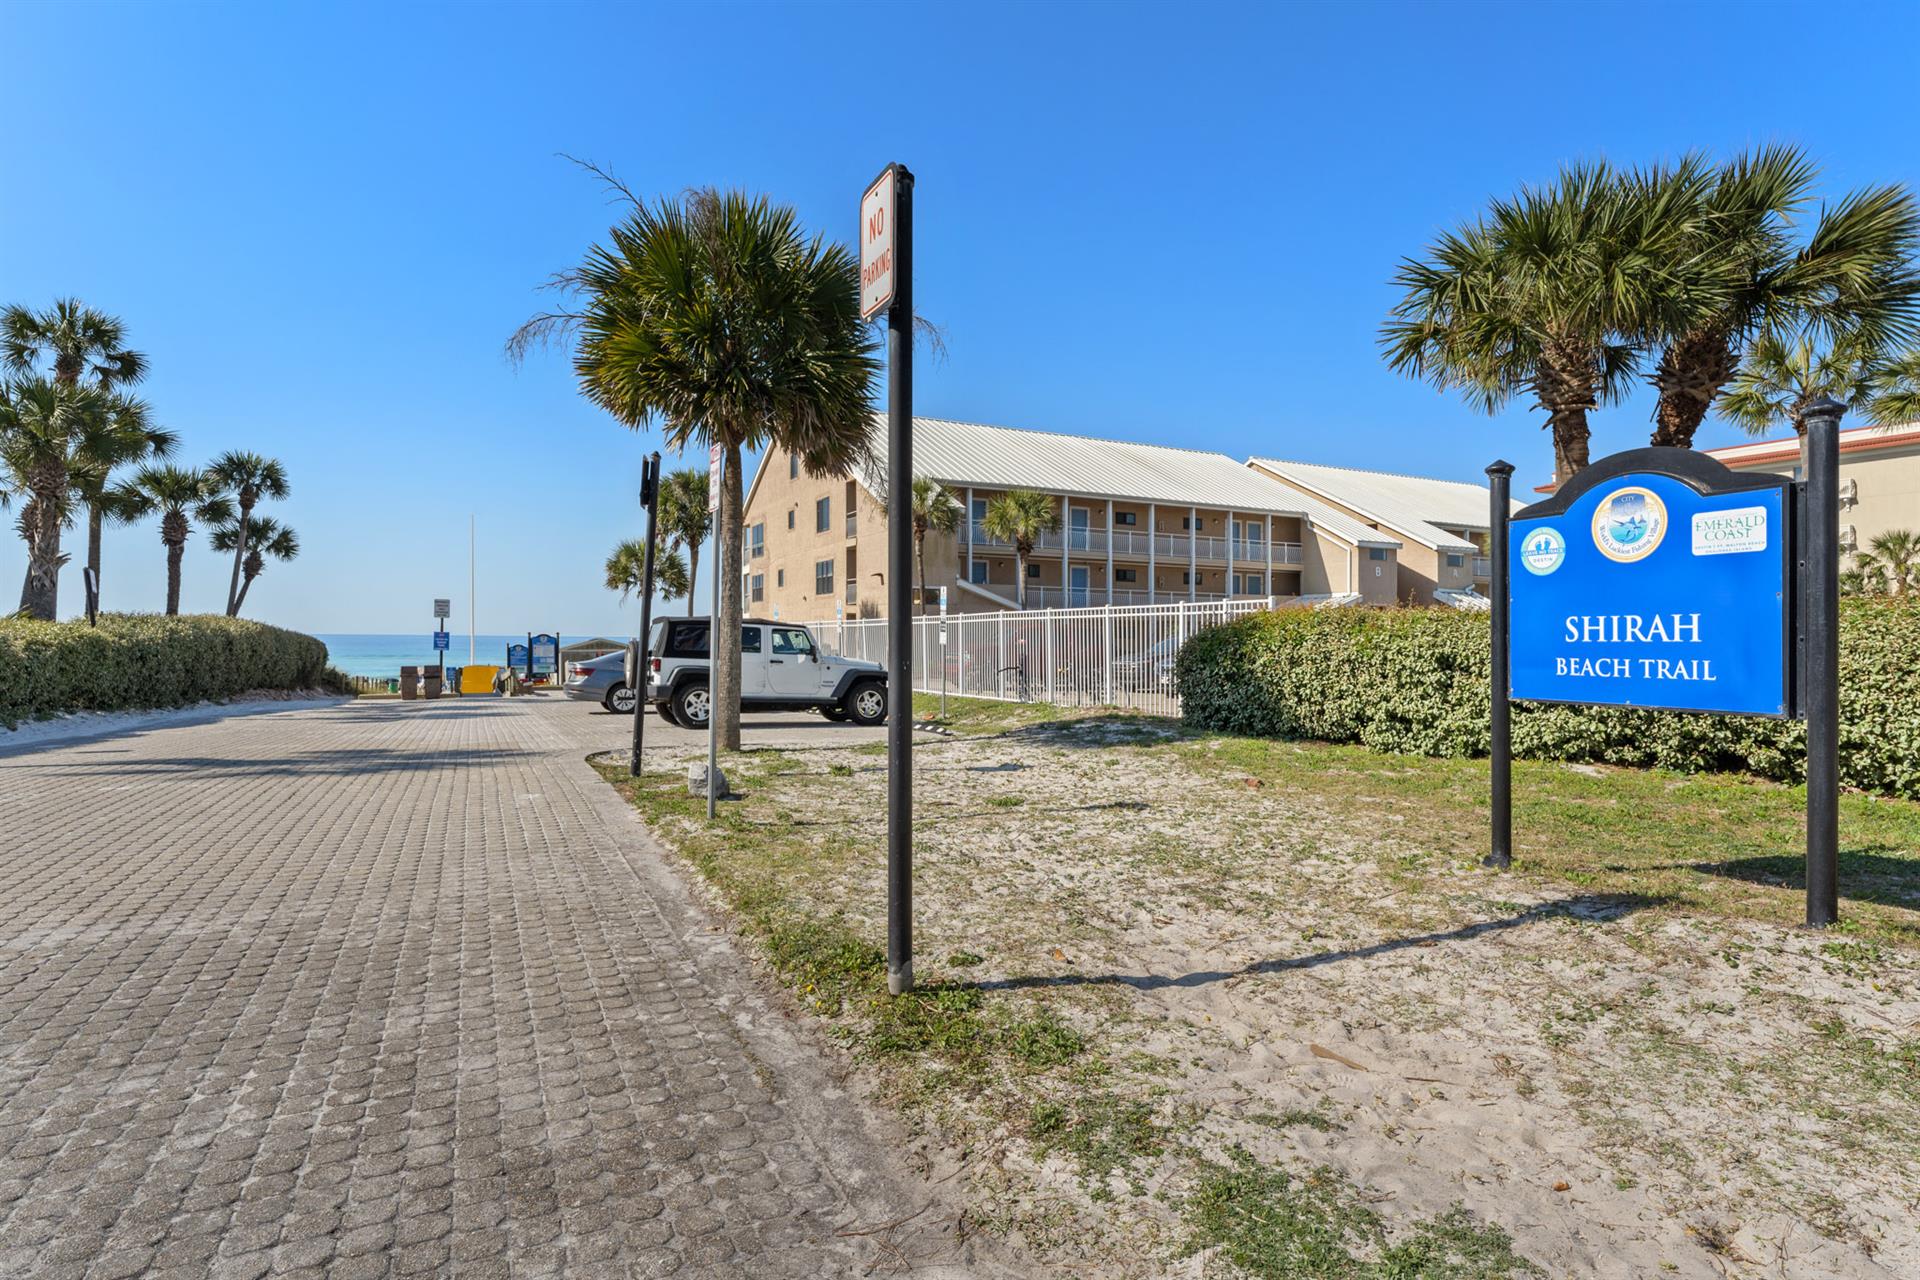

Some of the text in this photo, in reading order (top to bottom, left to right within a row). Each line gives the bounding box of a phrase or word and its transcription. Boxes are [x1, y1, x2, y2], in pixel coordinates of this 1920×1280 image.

[869, 207, 884, 244] NO
[862, 248, 890, 291] PARKING
[1696, 516, 1764, 532] EMERALD
[1704, 528, 1752, 542] COAST
[1376, 566, 1381, 576] B
[1565, 612, 1702, 643] SHIRAH
[1556, 657, 1716, 682] BEACH TRAIL
